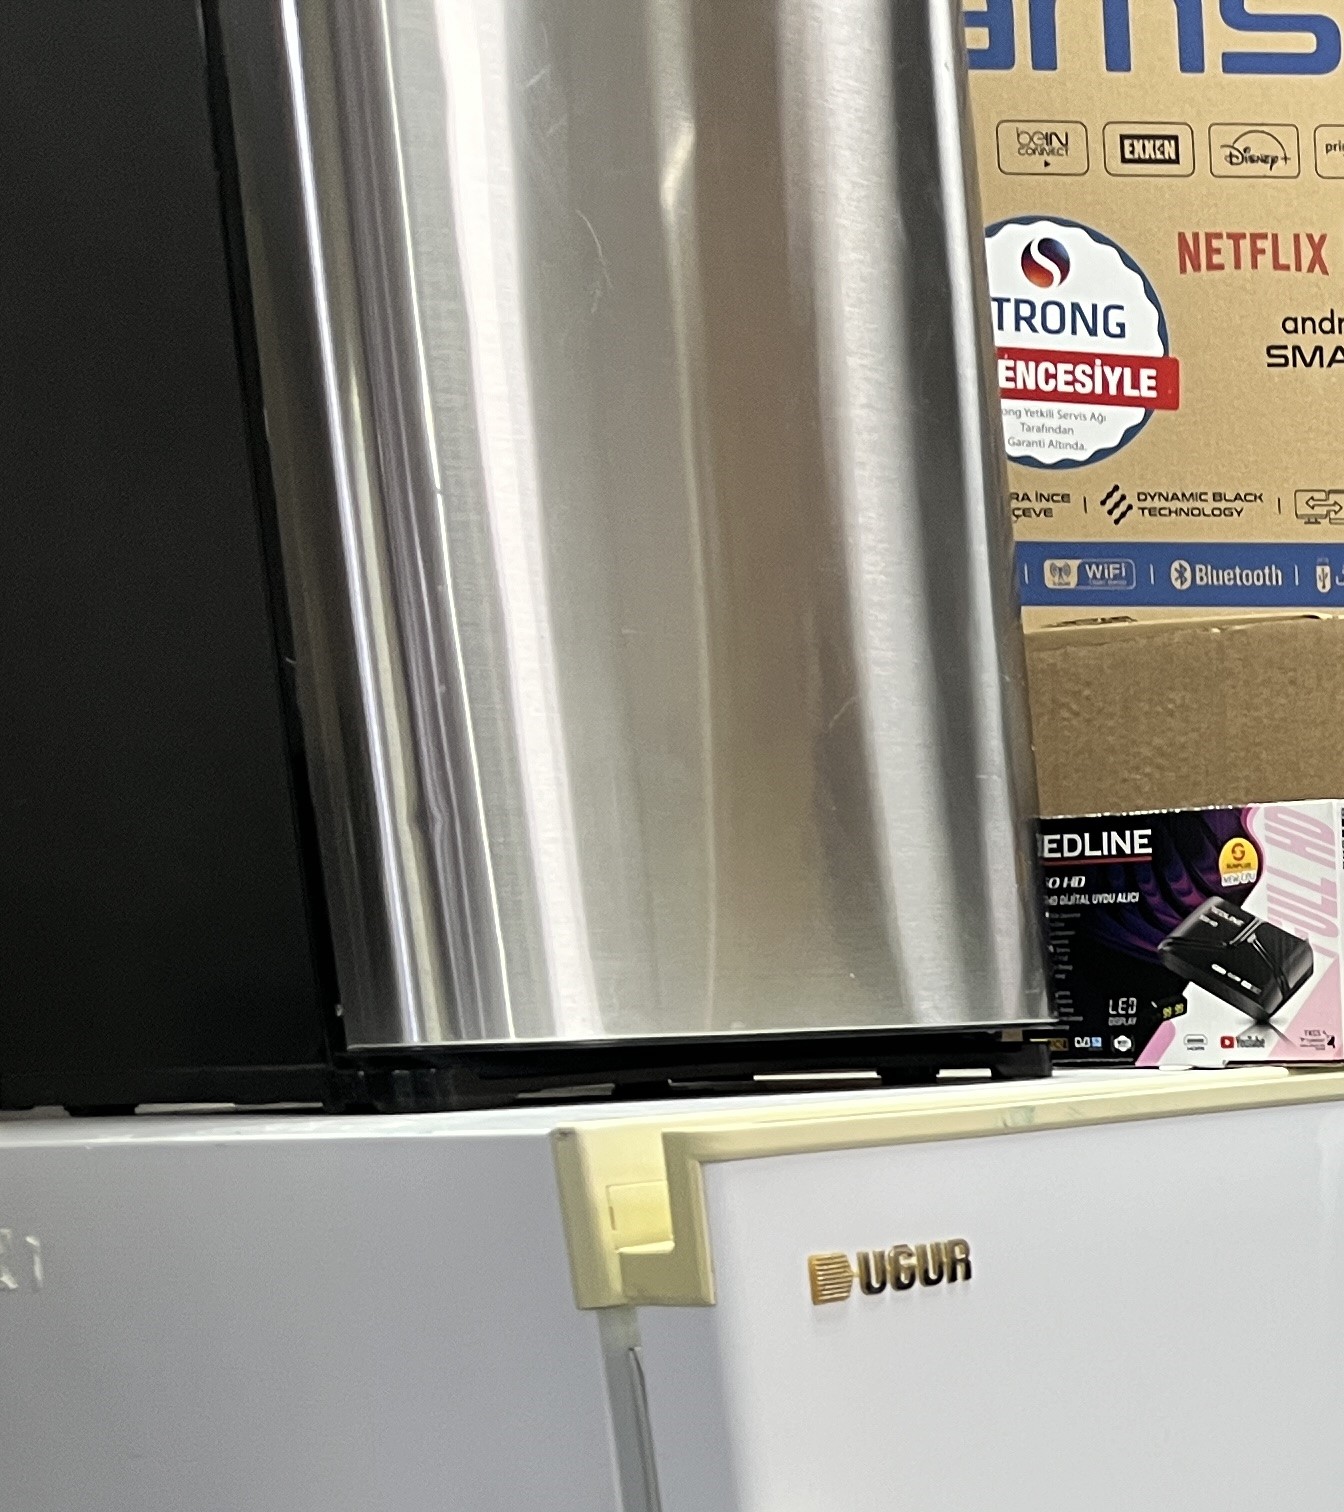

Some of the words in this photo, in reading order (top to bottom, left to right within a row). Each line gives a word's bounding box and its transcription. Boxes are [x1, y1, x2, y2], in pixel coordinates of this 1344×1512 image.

[1123, 138, 1178, 161] EXXEN
[1178, 231, 1330, 276] NETFLIX
[1057, 409, 1087, 421] Servis
[1020, 422, 1074, 435] Tarafından
[1008, 437, 1046, 449] Garanti
[1137, 492, 1209, 503] DYNAMIC
[1212, 492, 1264, 503] BLACK
[1138, 506, 1244, 518] TECHNOLOGY
[1195, 564, 1283, 587] Bluetooth
[857, 1238, 972, 1295] UĞUR
